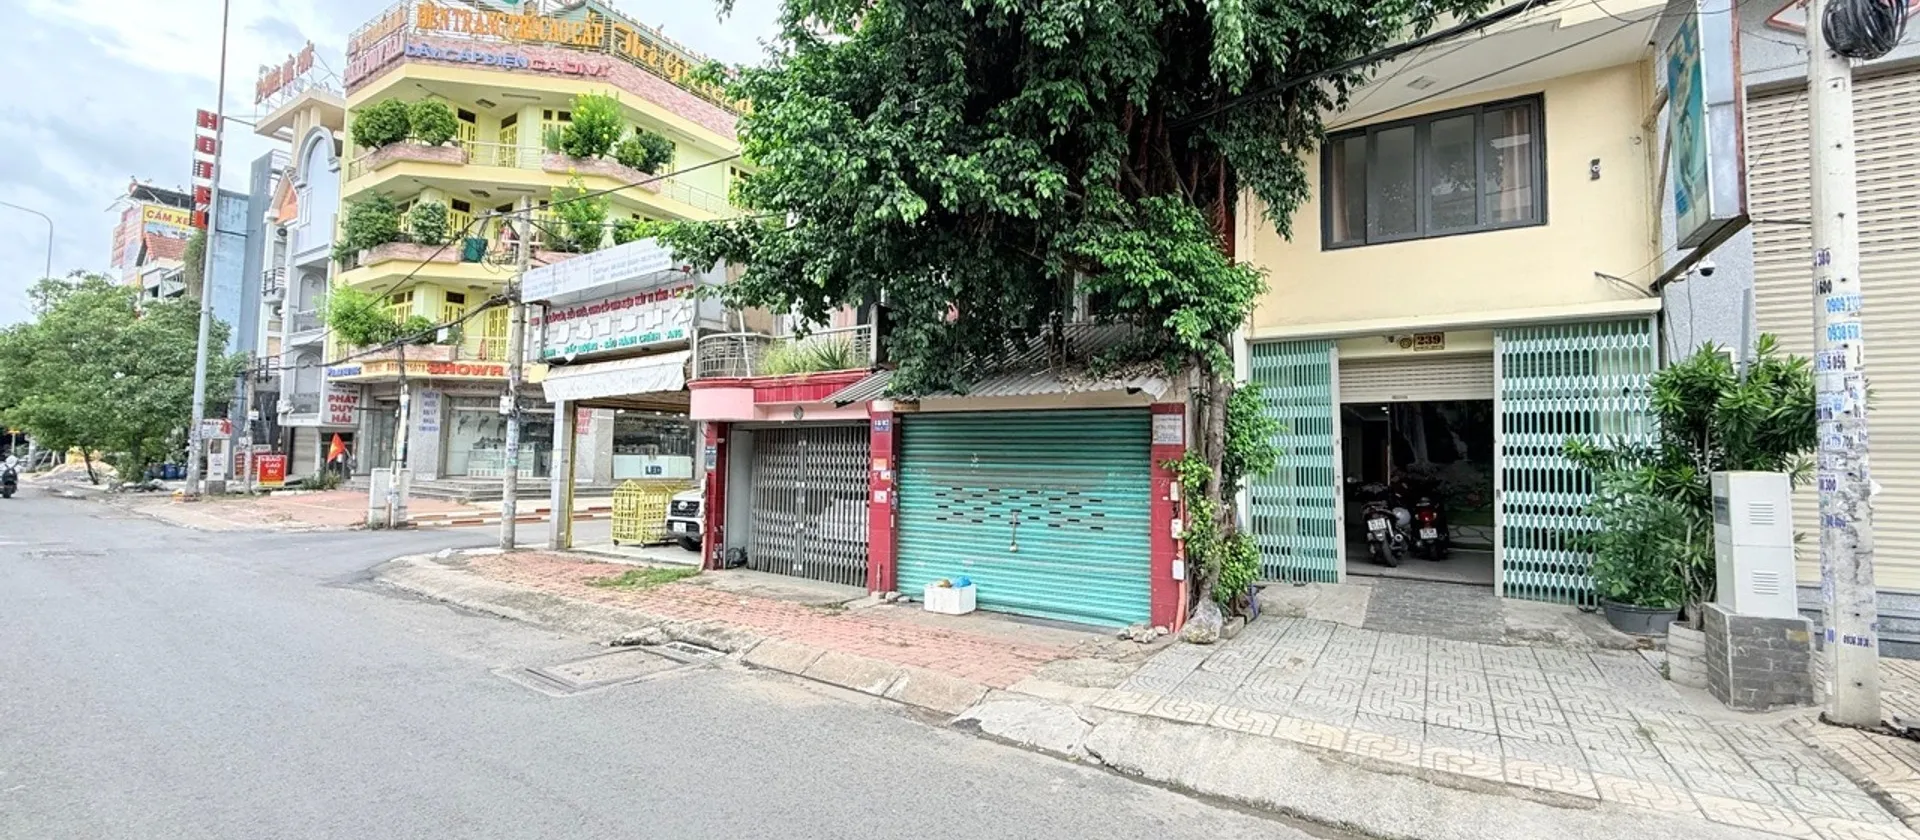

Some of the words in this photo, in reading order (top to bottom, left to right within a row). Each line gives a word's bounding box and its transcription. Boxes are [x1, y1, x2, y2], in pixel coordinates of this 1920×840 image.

[540, 17, 569, 42] CAO
[1416, 334, 1442, 346] 239
[645, 465, 662, 475] LED
